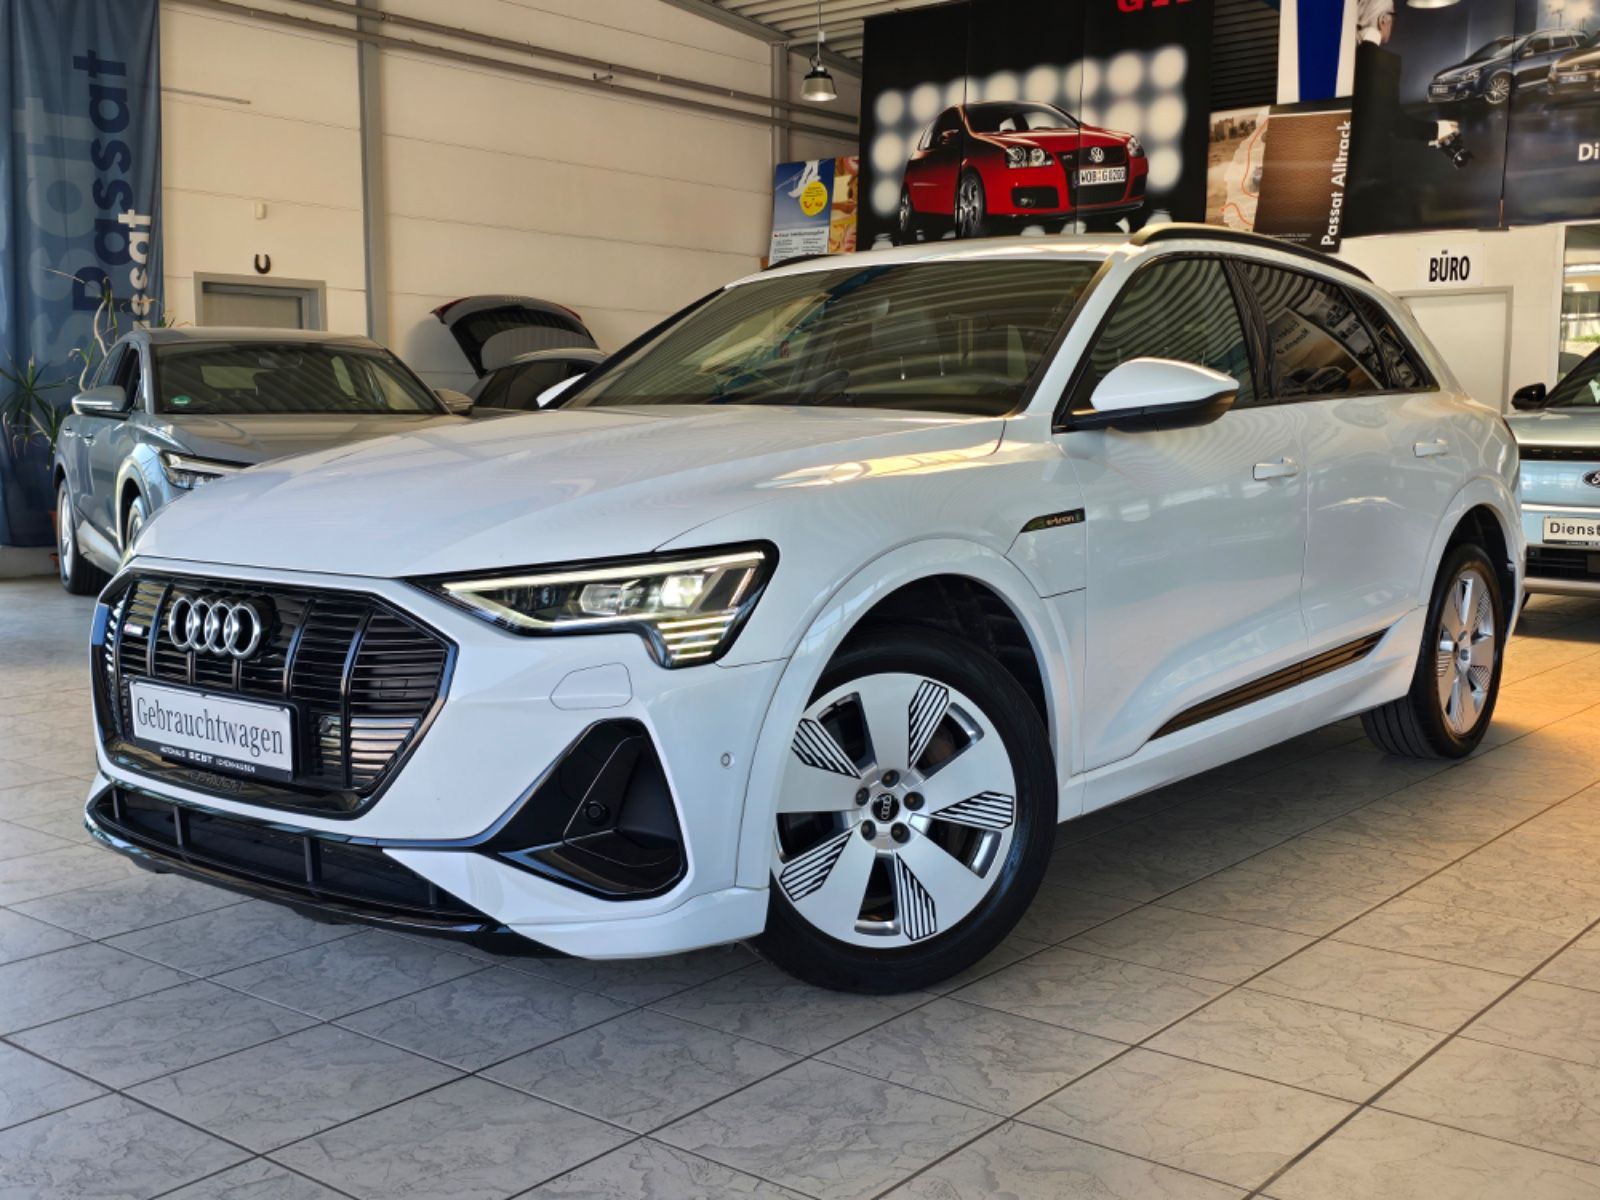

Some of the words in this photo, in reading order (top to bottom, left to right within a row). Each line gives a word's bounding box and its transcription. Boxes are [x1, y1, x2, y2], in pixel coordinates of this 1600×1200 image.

[72, 49, 138, 313] Passat
[1330, 120, 1351, 187] Alltrack
[1320, 191, 1344, 246] Passat
[1429, 249, 1470, 282] BÜRO
[1045, 515, 1075, 526] e-tron
[137, 697, 284, 758] Gebrauchtwagen
